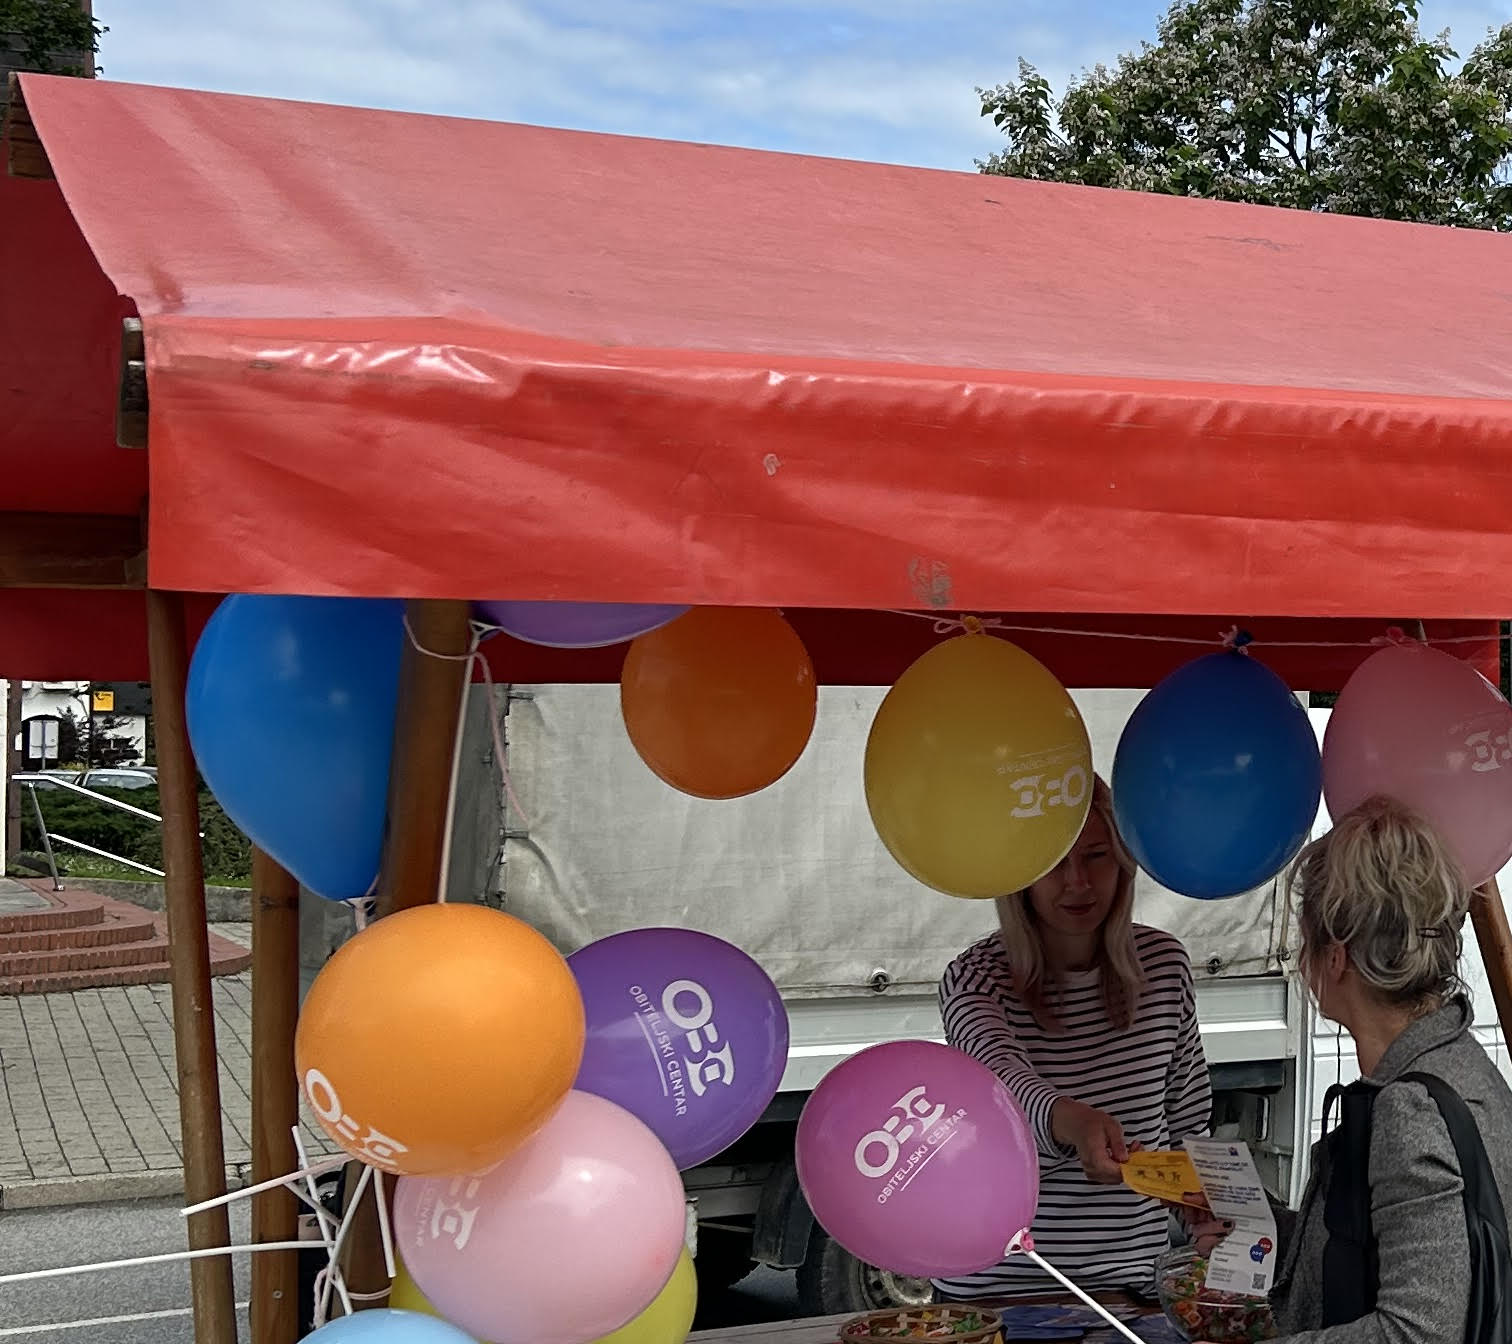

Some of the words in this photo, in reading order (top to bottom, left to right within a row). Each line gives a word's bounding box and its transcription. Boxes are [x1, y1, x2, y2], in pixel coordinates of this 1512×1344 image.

[629, 985, 676, 1058] OBITELJSKI
[667, 1060, 687, 1117] CENTAR
[662, 979, 735, 1096] OBC
[855, 1086, 945, 1177] OBC
[878, 1145, 928, 1204] OBITELJSKI
[927, 1108, 967, 1144] CENTAR
